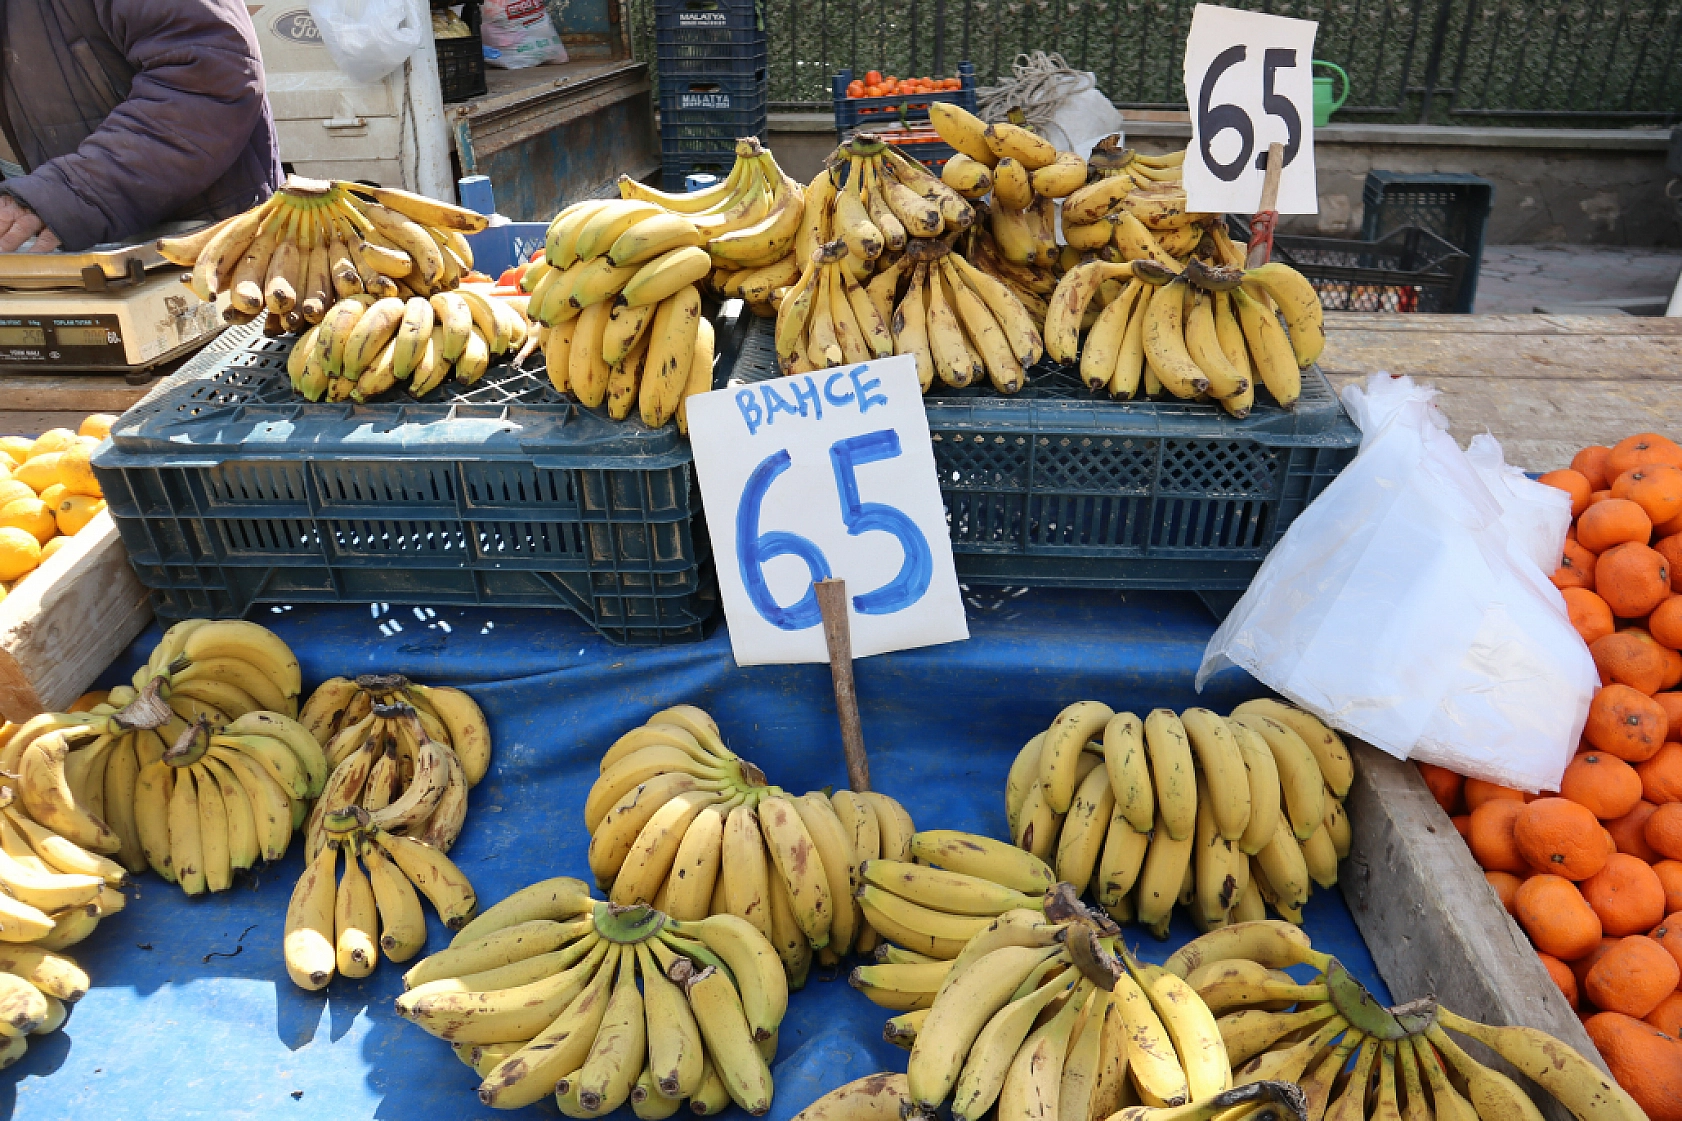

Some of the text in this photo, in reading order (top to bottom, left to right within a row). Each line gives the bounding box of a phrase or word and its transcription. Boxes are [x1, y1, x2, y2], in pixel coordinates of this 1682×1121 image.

[291, 15, 322, 38] For
[680, 12, 727, 21] MALATYA
[682, 94, 730, 105] MALATYA
[1198, 44, 1301, 181] 65
[735, 364, 888, 435] BAHCE
[735, 428, 933, 631] 65
